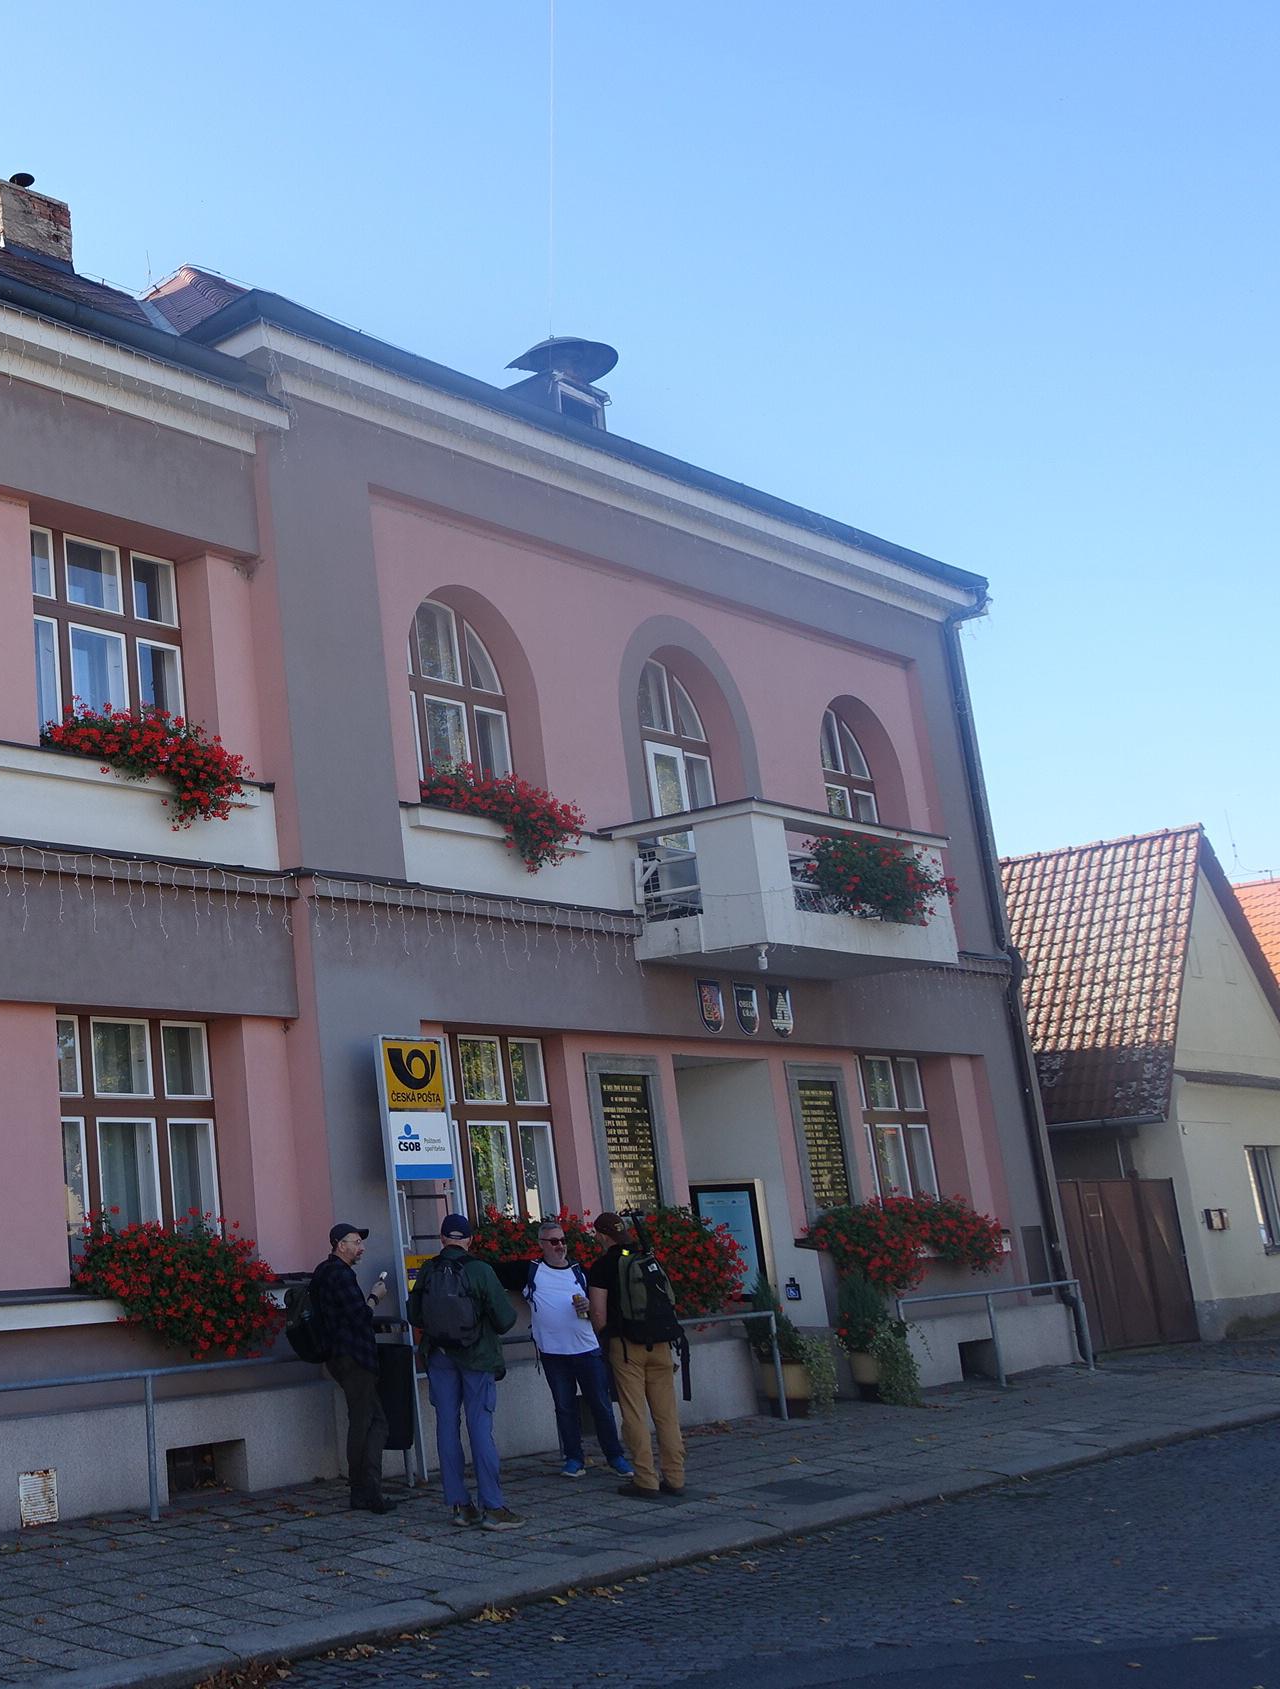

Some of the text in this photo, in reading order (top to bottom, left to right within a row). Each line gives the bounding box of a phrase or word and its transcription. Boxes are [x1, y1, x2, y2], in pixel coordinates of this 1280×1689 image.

[391, 1090, 441, 1103] ČESKÁ POŠTA
[398, 1140, 421, 1151] ČSOB
